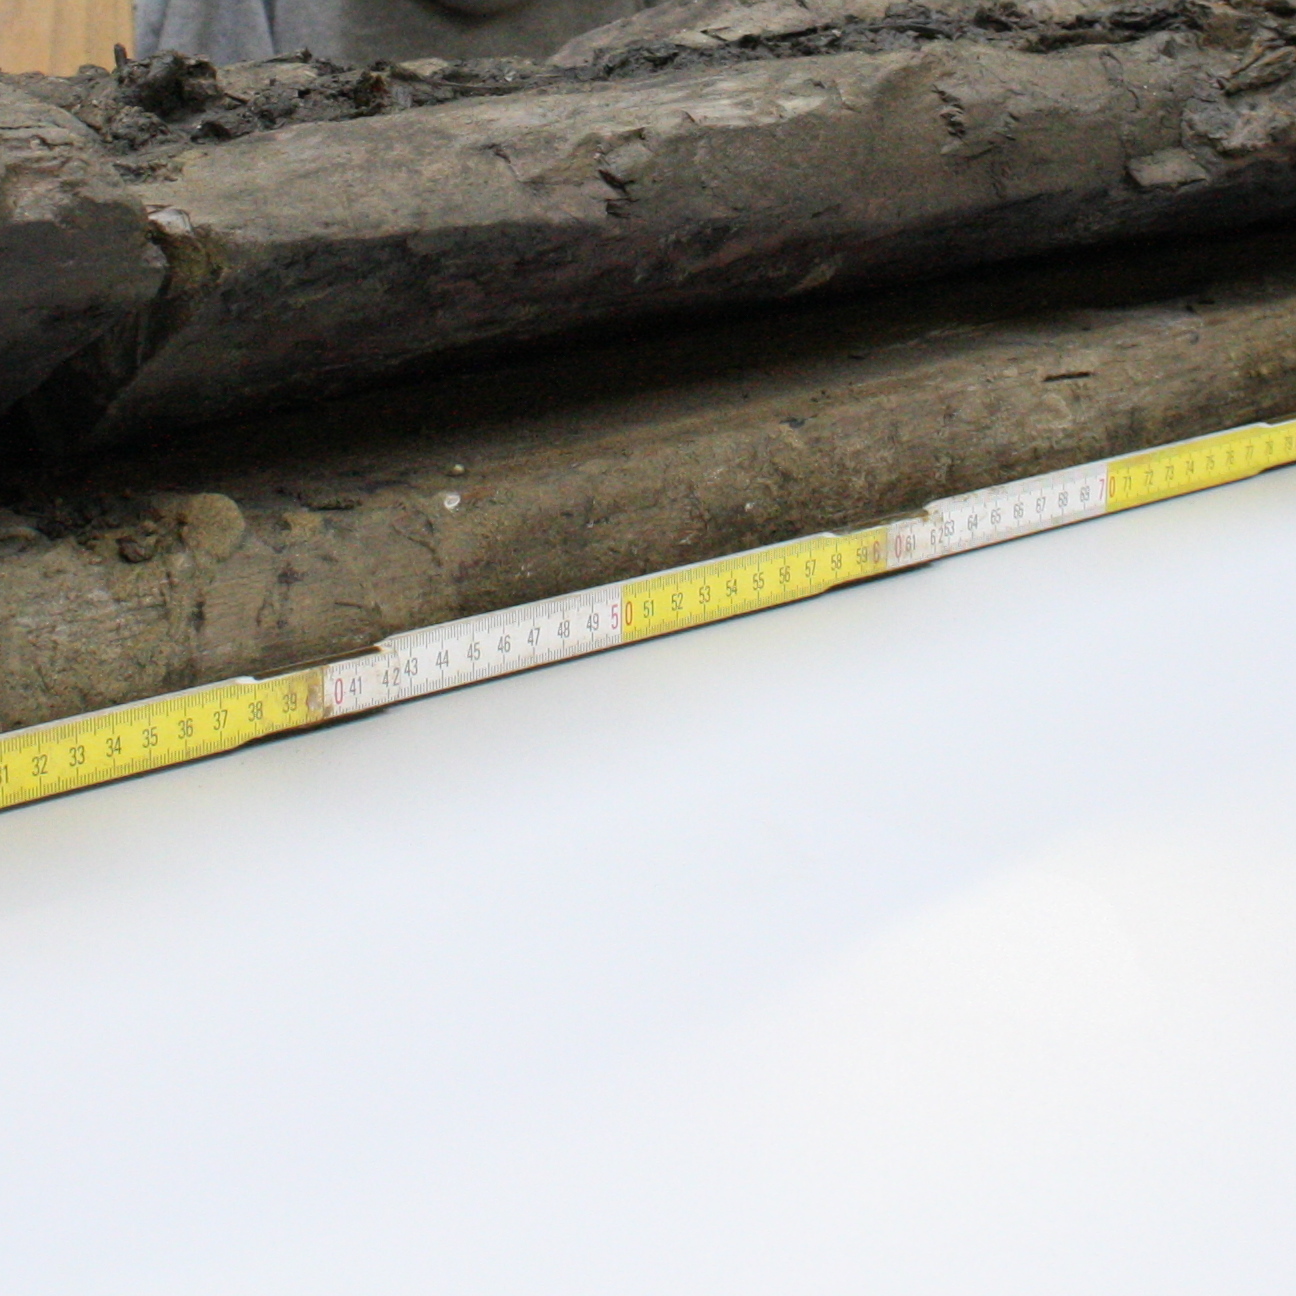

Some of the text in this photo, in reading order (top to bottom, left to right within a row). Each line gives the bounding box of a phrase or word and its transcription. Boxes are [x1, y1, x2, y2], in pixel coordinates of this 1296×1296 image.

[31, 754, 48, 777] 32
[69, 744, 86, 767] 33
[106, 736, 122, 758] 34
[142, 726, 158, 749] 35
[178, 717, 194, 740] 36
[213, 709, 228, 731] 37
[248, 700, 263, 722] 38
[282, 692, 297, 714] 39
[349, 676, 363, 695] 41
[404, 657, 418, 677] 43
[435, 649, 449, 670] 44
[467, 642, 481, 662] 45
[497, 634, 511, 654] 46
[527, 627, 541, 646] 47
[557, 619, 571, 639] 48
[586, 612, 600, 632] 49
[643, 599, 654, 619] 51
[671, 592, 684, 612] 52
[698, 585, 711, 604] 53
[725, 578, 738, 597] 54
[752, 571, 765, 591] 55
[779, 565, 791, 585] 56
[804, 558, 817, 578] 57
[830, 552, 843, 572] 58
[856, 546, 868, 565] 59
[905, 534, 916, 552] 61
[944, 519, 955, 537] 63
[967, 513, 978, 531] 64
[990, 507, 1002, 526] 65
[1013, 502, 1024, 520] 66
[1035, 496, 1046, 514] 67
[1057, 490, 1069, 508] 68
[1079, 485, 1091, 503] 69
[1123, 475, 1133, 492] 71
